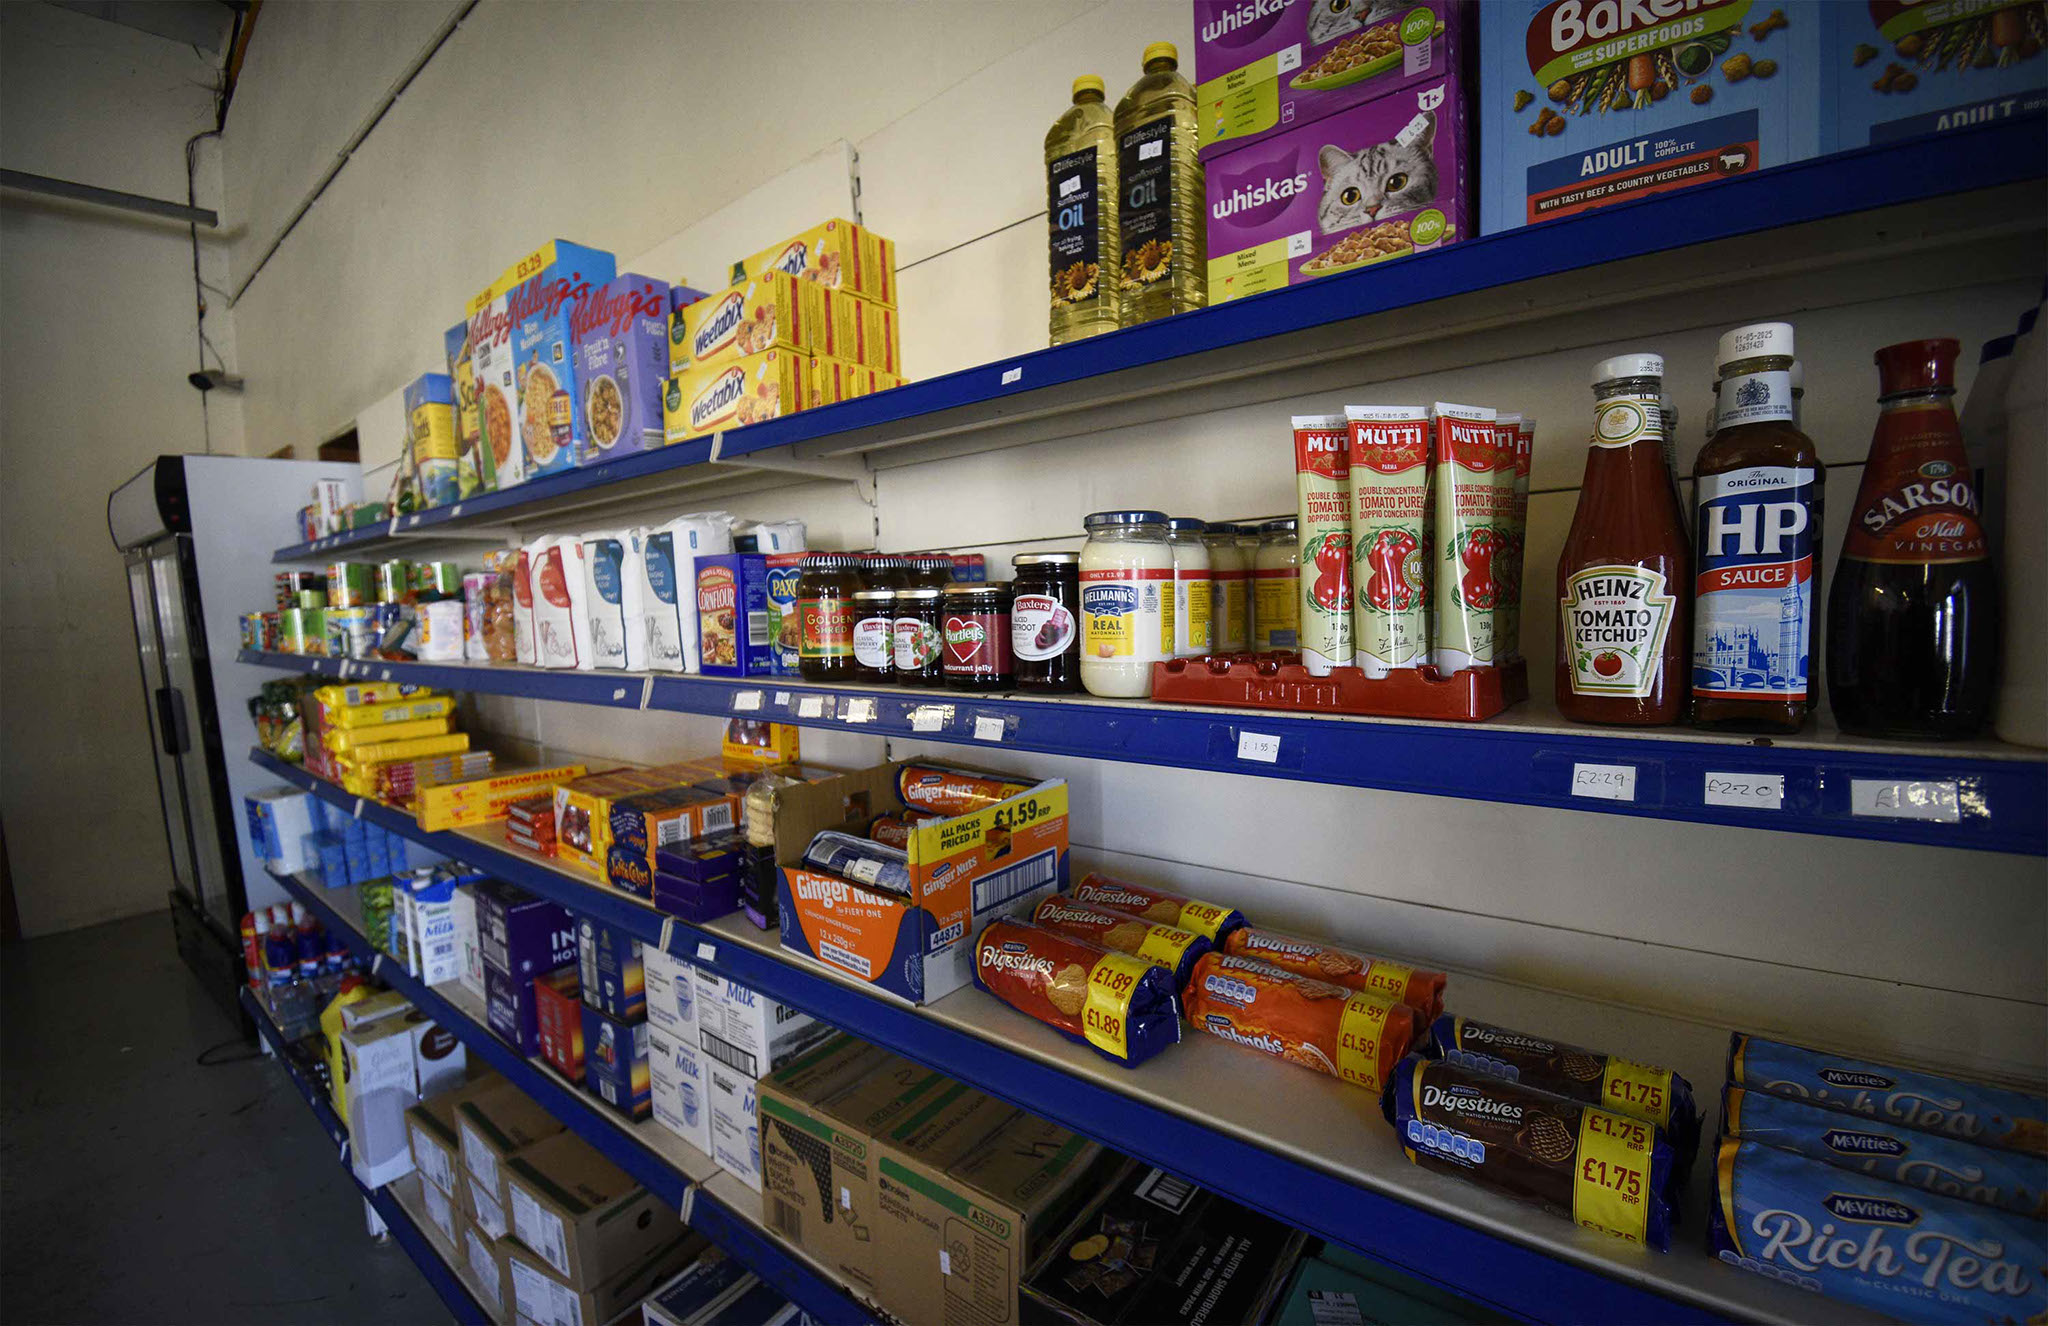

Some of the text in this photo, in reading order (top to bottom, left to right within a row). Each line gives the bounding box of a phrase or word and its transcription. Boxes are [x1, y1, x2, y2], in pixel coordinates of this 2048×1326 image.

[1596, 16, 1705, 62] SUPERFOODS
[1226, 69, 1247, 84] Mixed
[1227, 79, 1246, 92] Menu
[1654, 138, 1677, 150] 100%
[1655, 142, 1696, 158] COMPLETE
[1580, 140, 1649, 177] ADULT
[1129, 178, 1159, 209] Oil
[1213, 172, 1310, 220] whiskas
[1540, 162, 1710, 211] WITH TASTY BEEF & COUNTRY VEGETABLES
[1058, 203, 1085, 231] Oil
[1237, 249, 1258, 262] Mixed
[1238, 258, 1257, 270] Menu
[517, 253, 543, 280] £3.29
[570, 283, 665, 345] Kellogg's
[695, 296, 745, 354] Weetabix
[691, 371, 746, 427] Weetabix
[1357, 428, 1422, 445] MUTTI
[1727, 477, 1788, 488] ORIGINAL
[1748, 470, 1767, 479] The
[1307, 492, 1331, 501] DOUBLE
[1359, 487, 1383, 495] DOUBLE
[1307, 501, 1344, 514] TOMATO
[1359, 496, 1396, 509] TOMATO
[1307, 514, 1330, 523] DOPPIO
[1359, 510, 1383, 520] DOPPIO
[1705, 501, 1808, 557] HP
[1916, 520, 1965, 539] Malt
[1720, 568, 1786, 586] SAUCE
[697, 587, 736, 612] CORNFLOUR
[1084, 589, 1136, 605] HELLMANN'S
[1577, 579, 1645, 601] HEINZ
[1016, 599, 1051, 611] Baxters
[806, 613, 855, 626] GOLDEN
[1092, 619, 1123, 632] REAL
[1573, 609, 1652, 627] TOMATO
[814, 625, 849, 636] SHRED
[1576, 629, 1648, 643] KETCHUP
[975, 664, 993, 674] jelly
[489, 766, 574, 788] SNOWBALLS
[908, 784, 944, 804] Ginger
[993, 799, 1051, 828] £1.59 RRP
[940, 818, 981, 840] ALL PACKS
[941, 829, 982, 851] PRICED AT
[922, 855, 978, 897] Ginger Nuts
[796, 873, 850, 909] Ginger
[1078, 885, 1150, 907] Digestives
[844, 907, 883, 919] FIERY ONE
[1039, 903, 1116, 927] Digestives
[1186, 903, 1222, 921] £1.89
[424, 921, 454, 938] Milk
[932, 923, 963, 946] 44873
[1152, 924, 1191, 943] £1.89
[981, 945, 1055, 976] Digestives
[1093, 966, 1134, 992] £1.89
[1370, 974, 1403, 993] £1.59
[726, 980, 756, 1009] Milk
[1350, 1002, 1385, 1020] £1.59
[1087, 1007, 1121, 1037] £1.89
[1342, 1032, 1375, 1052] £1.59
[1463, 1026, 1555, 1052] Digestives
[674, 1053, 700, 1081] Milk
[1342, 1068, 1375, 1087] £1.59
[1827, 1071, 1887, 1087] McVitie's
[1423, 1085, 1523, 1120] Digestives
[1609, 1078, 1663, 1108] £1.75
[1645, 1105, 1662, 1116] RRP
[1588, 1114, 1647, 1144] £1.75
[1626, 1141, 1645, 1153] RRP
[1832, 1134, 1899, 1151] McVitie's
[1583, 1157, 1642, 1197] £1.75
[1622, 1193, 1640, 1205] RRP
[1834, 1198, 1910, 1220] McVitie's
[971, 1208, 1006, 1236] A33719
[1752, 1209, 2033, 1297] Rich Tea
